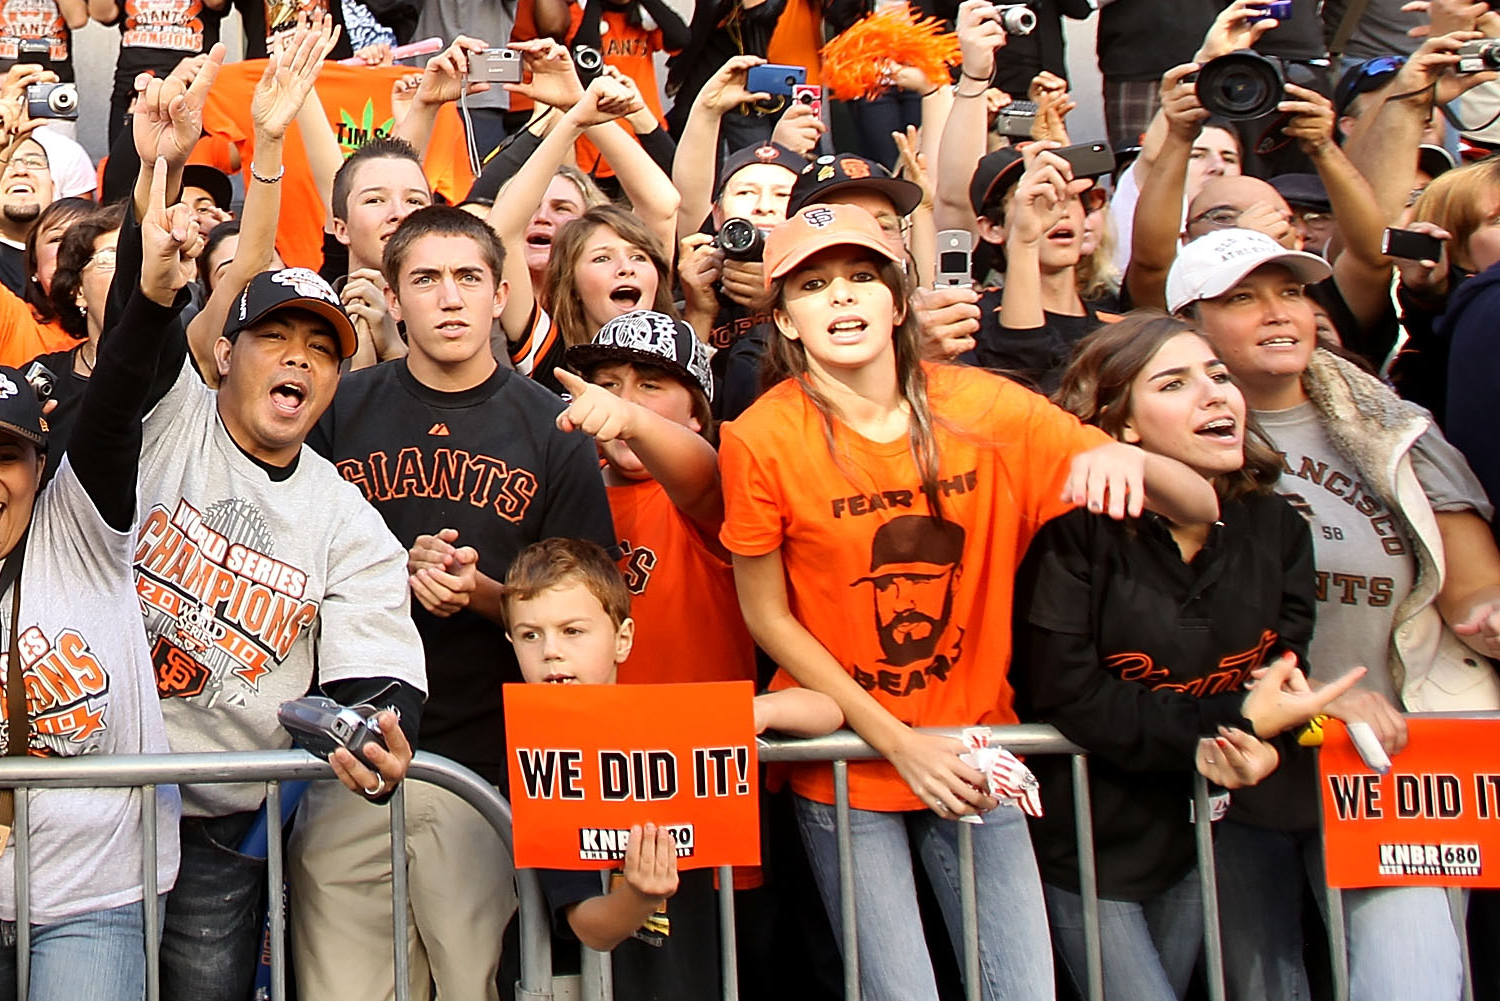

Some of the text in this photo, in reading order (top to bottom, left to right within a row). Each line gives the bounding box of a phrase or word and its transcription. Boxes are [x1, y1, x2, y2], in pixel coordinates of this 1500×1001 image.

[135, 11, 189, 25] GIANTS
[123, 31, 203, 50] CHAMPIONS
[336, 123, 369, 145] TIM
[803, 207, 836, 229] SF
[336, 446, 539, 524] GIANTS
[832, 489, 913, 518] FEAR
[175, 501, 305, 598] WORLD SERIES
[134, 504, 319, 662] CHAMPIONS
[141, 582, 178, 609] 20
[174, 615, 215, 650] SERIES
[177, 600, 227, 640] WORLD
[229, 636, 259, 662] 10
[45, 715, 76, 734] 10
[516, 745, 749, 801] WE DID IT!
[1328, 773, 1383, 821] WE
[1394, 773, 1464, 820] DID
[582, 826, 692, 851] KNB 80
[1381, 844, 1478, 866] KNBR 680
